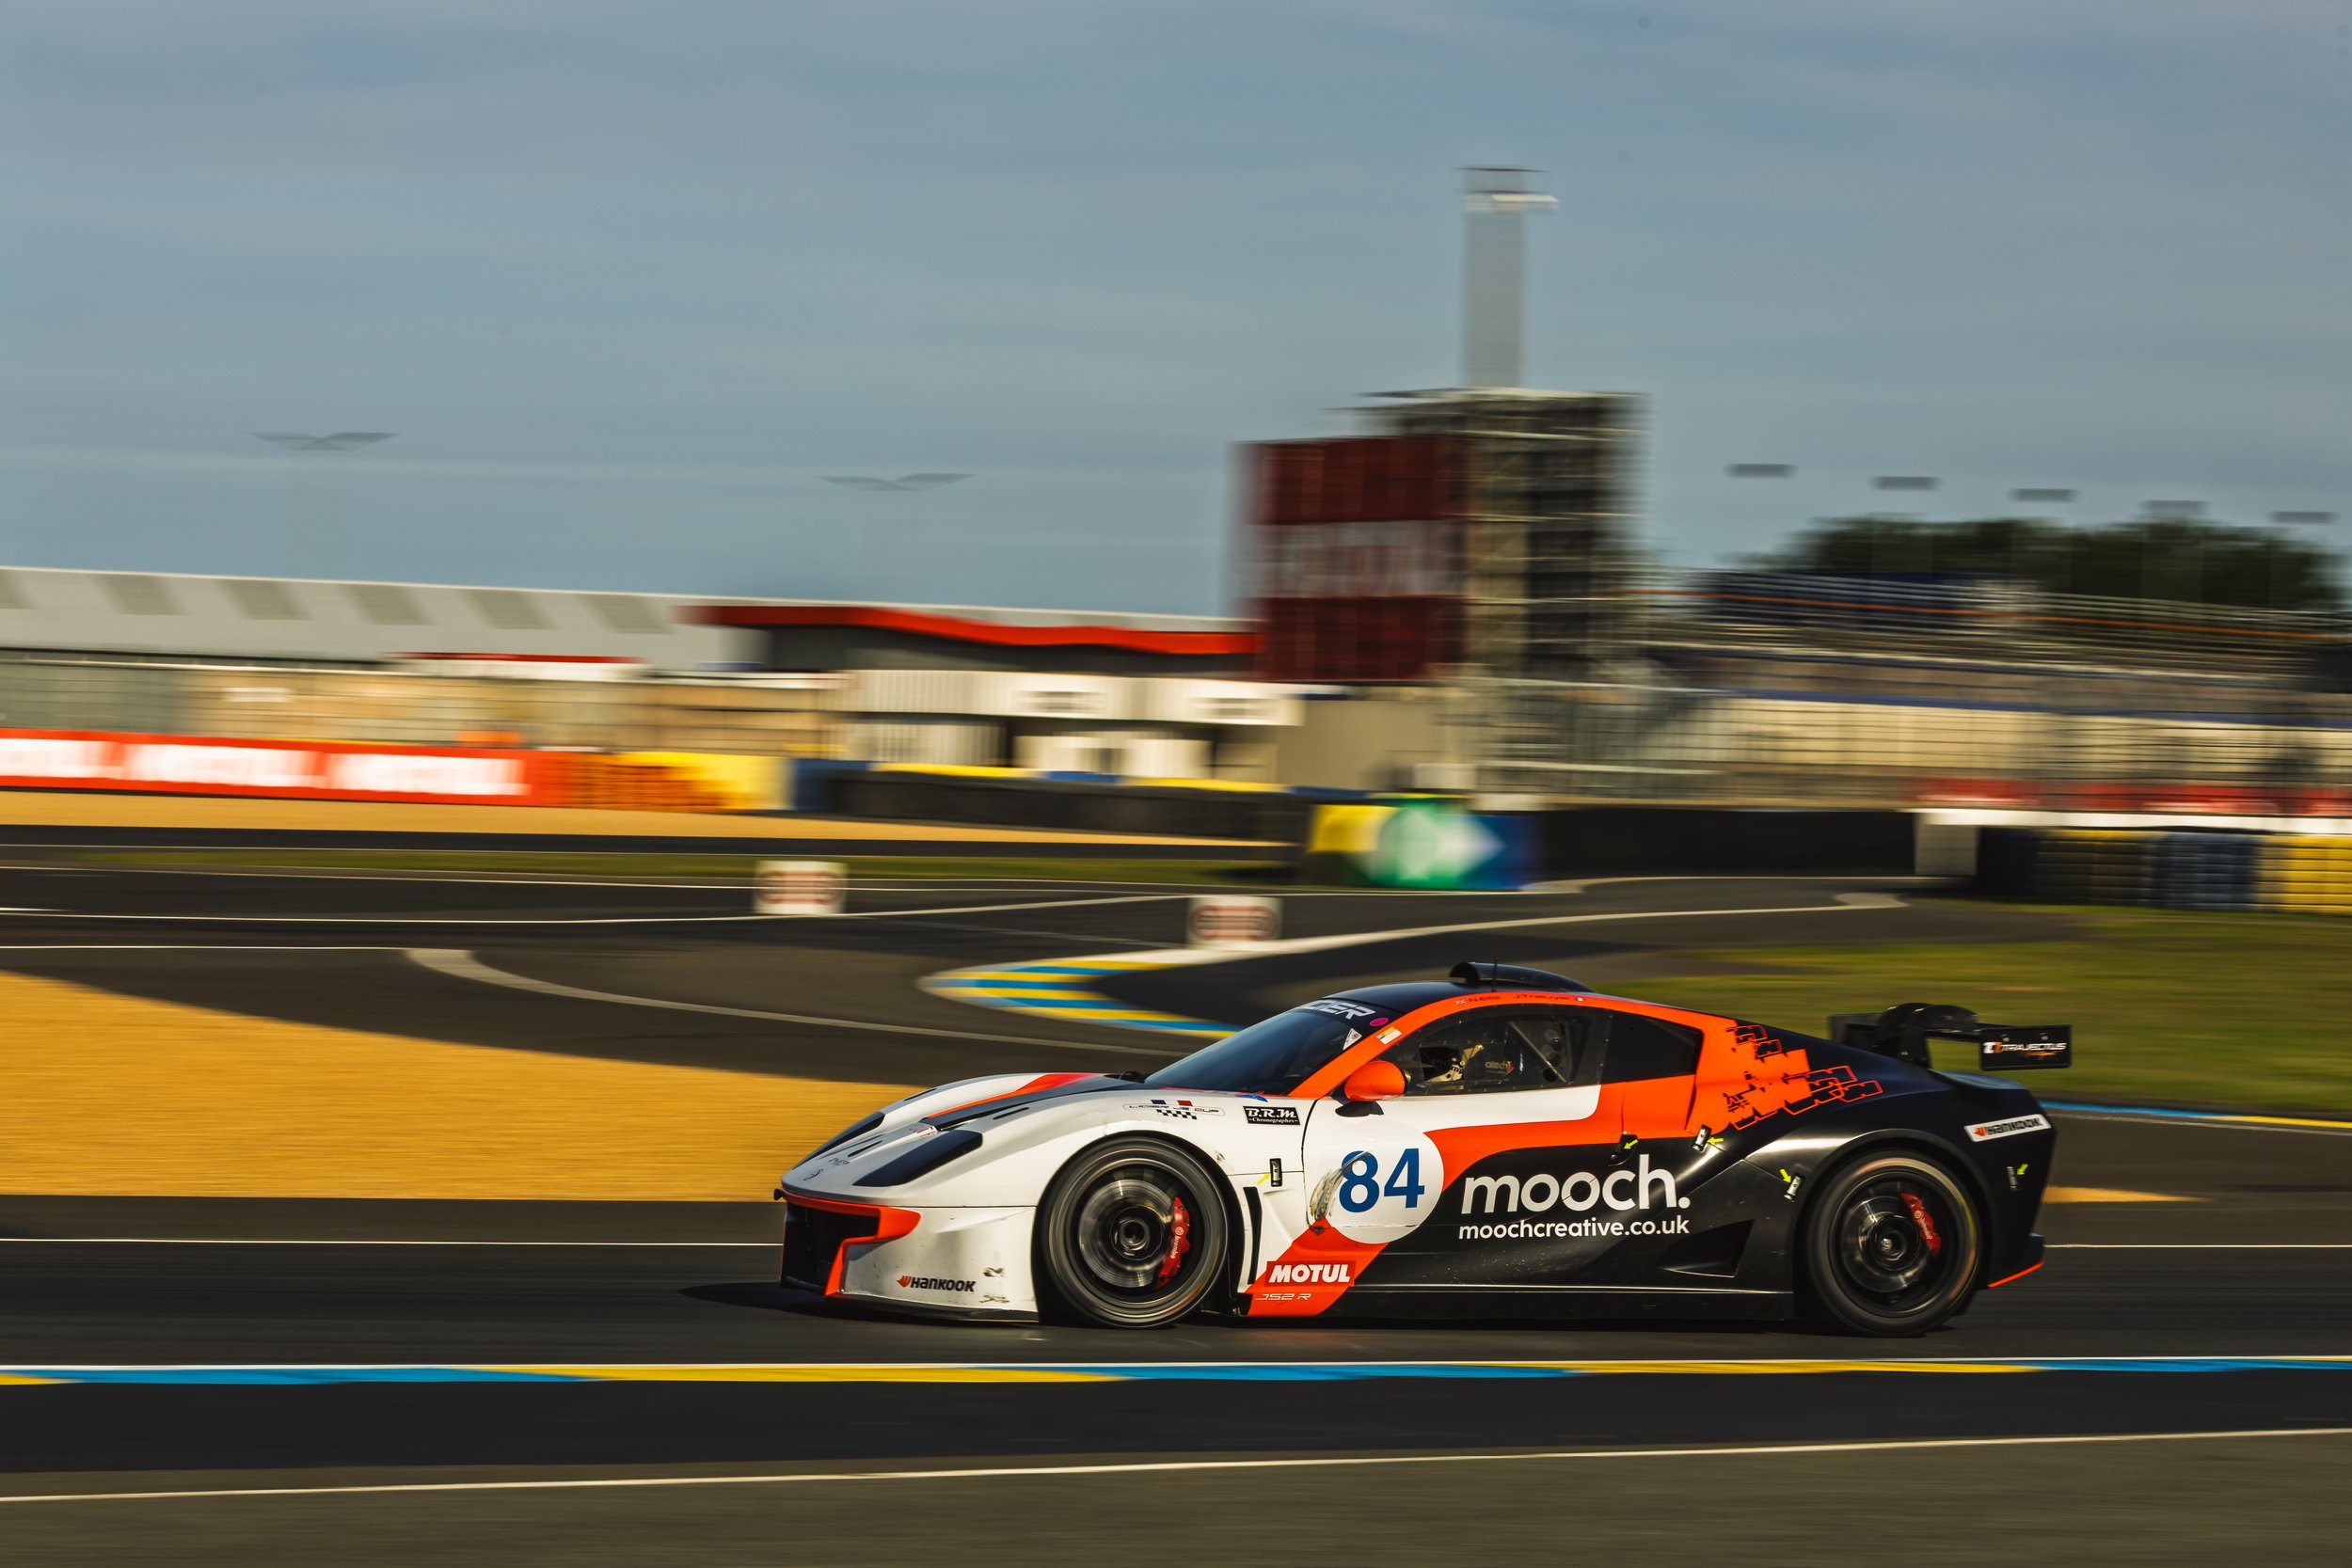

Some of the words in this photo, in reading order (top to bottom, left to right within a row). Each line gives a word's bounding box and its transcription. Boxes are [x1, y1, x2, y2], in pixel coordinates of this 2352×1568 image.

[1339, 1148, 1425, 1213] 84
[1461, 1153, 1691, 1214] mooch.
[1458, 1214, 1691, 1240] moochcreative.co.uk
[1268, 1264, 1351, 1283] MOTUL
